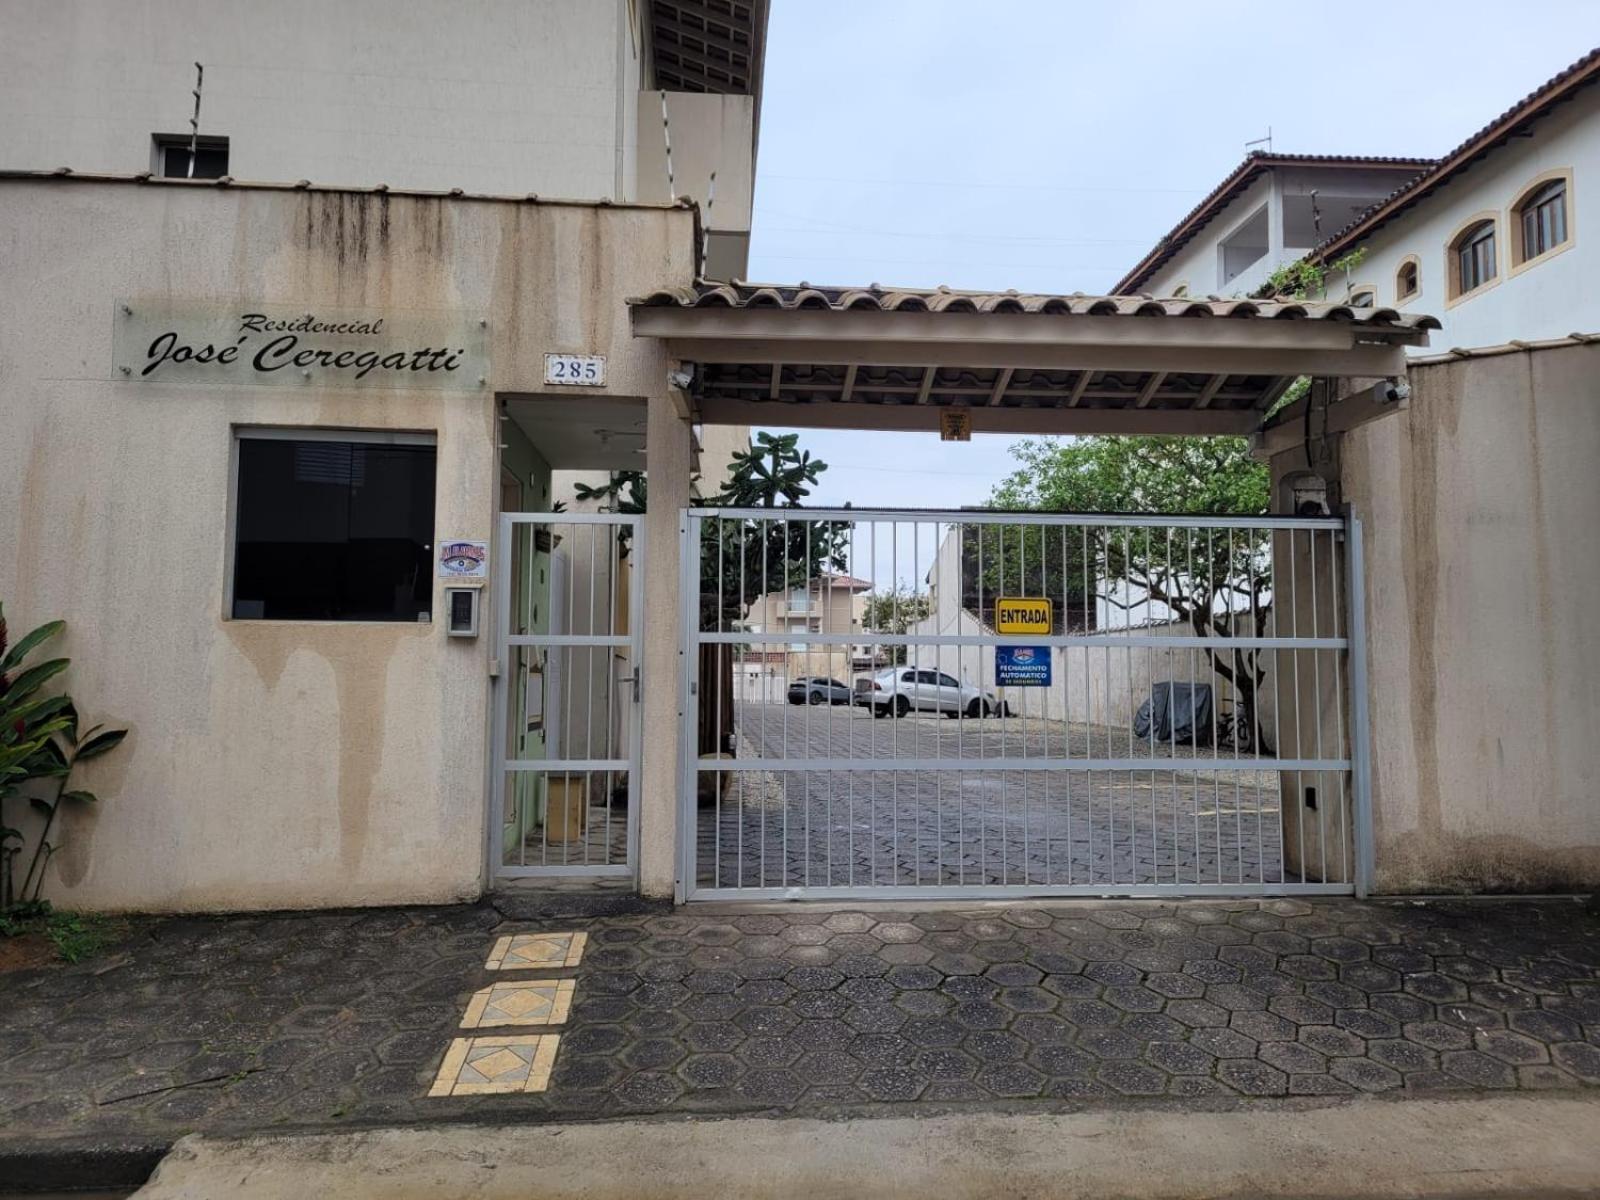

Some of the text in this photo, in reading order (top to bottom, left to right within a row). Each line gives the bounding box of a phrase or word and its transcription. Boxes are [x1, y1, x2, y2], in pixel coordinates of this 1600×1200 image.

[238, 313, 384, 335] Residencial
[141, 332, 465, 380] José Ceregatti
[554, 361, 596, 379] 285
[1000, 609, 1048, 624] ENTRADA
